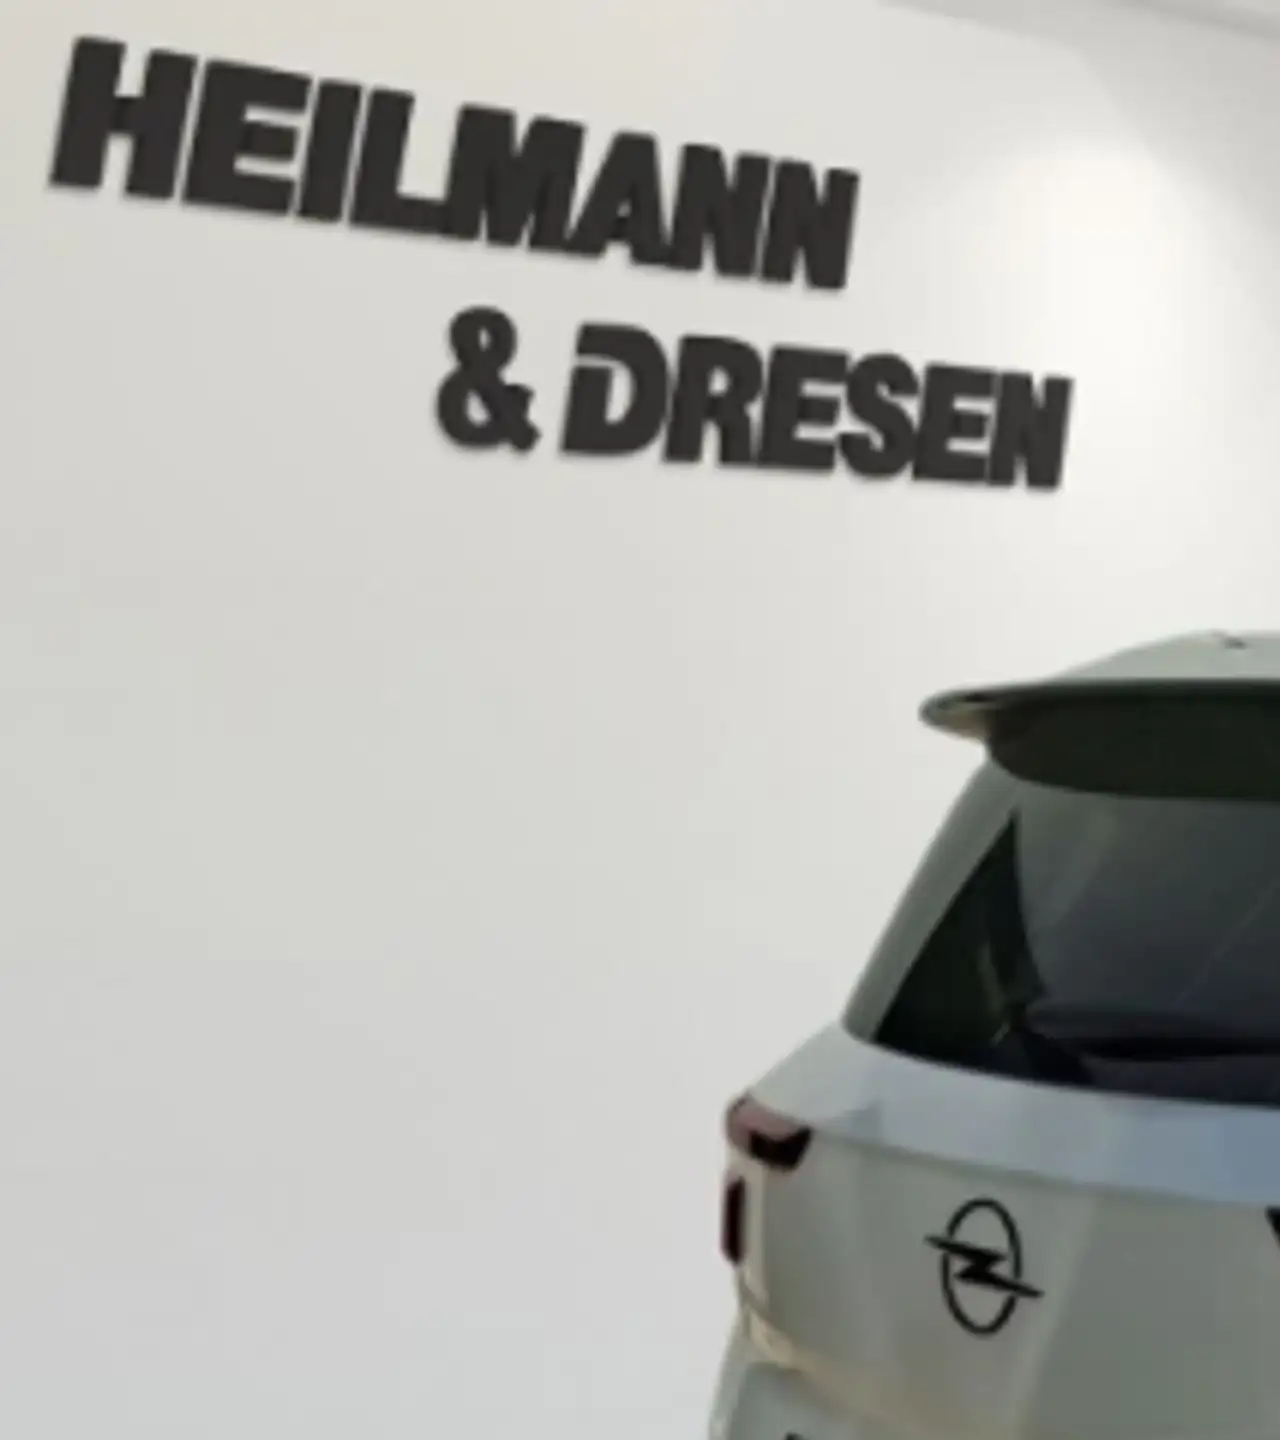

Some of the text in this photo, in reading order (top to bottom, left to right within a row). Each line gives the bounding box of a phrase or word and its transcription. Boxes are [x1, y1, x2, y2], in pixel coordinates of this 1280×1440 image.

[49, 37, 859, 290] HEILMANN
[435, 306, 1073, 490] & DRESEN
